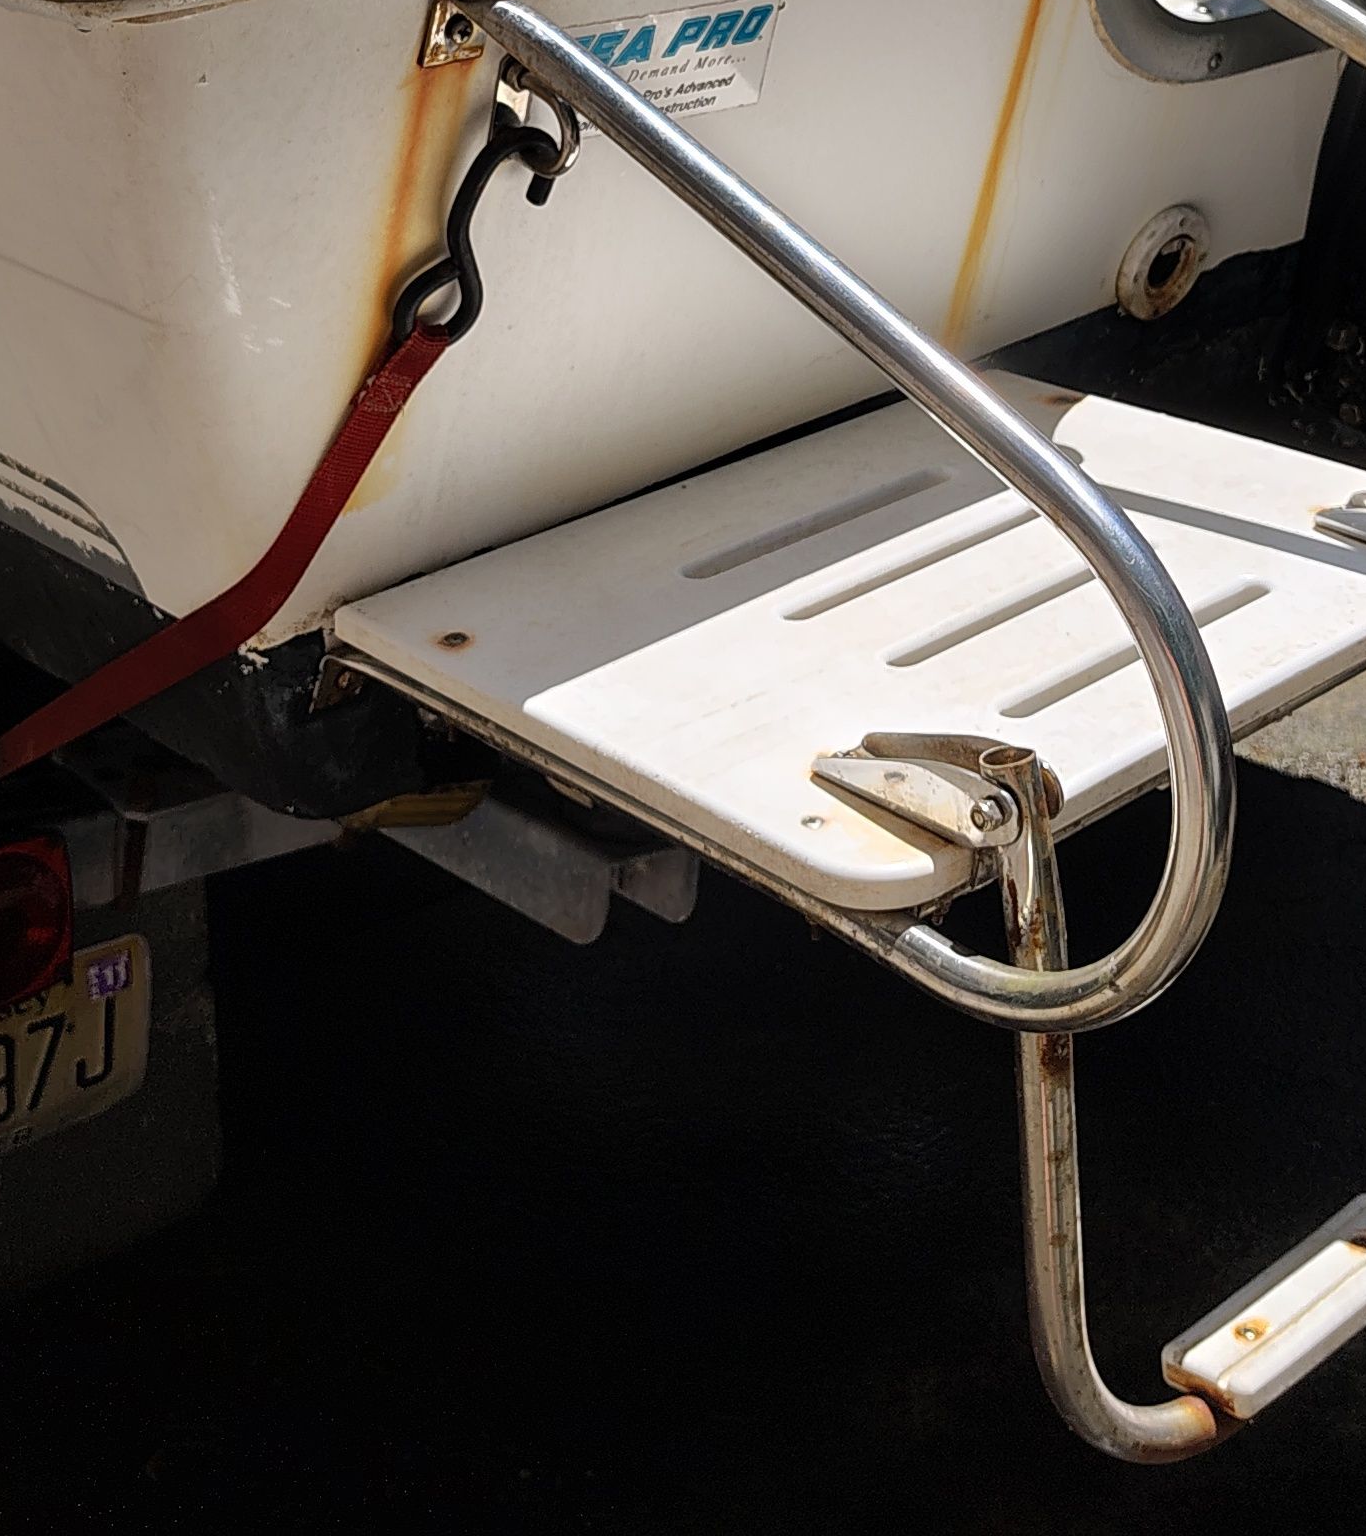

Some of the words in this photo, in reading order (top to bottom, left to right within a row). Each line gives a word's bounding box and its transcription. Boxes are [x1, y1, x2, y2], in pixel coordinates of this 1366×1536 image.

[661, 4, 774, 59] PRO
[626, 59, 689, 84] Demand
[674, 73, 736, 97] Advanced
